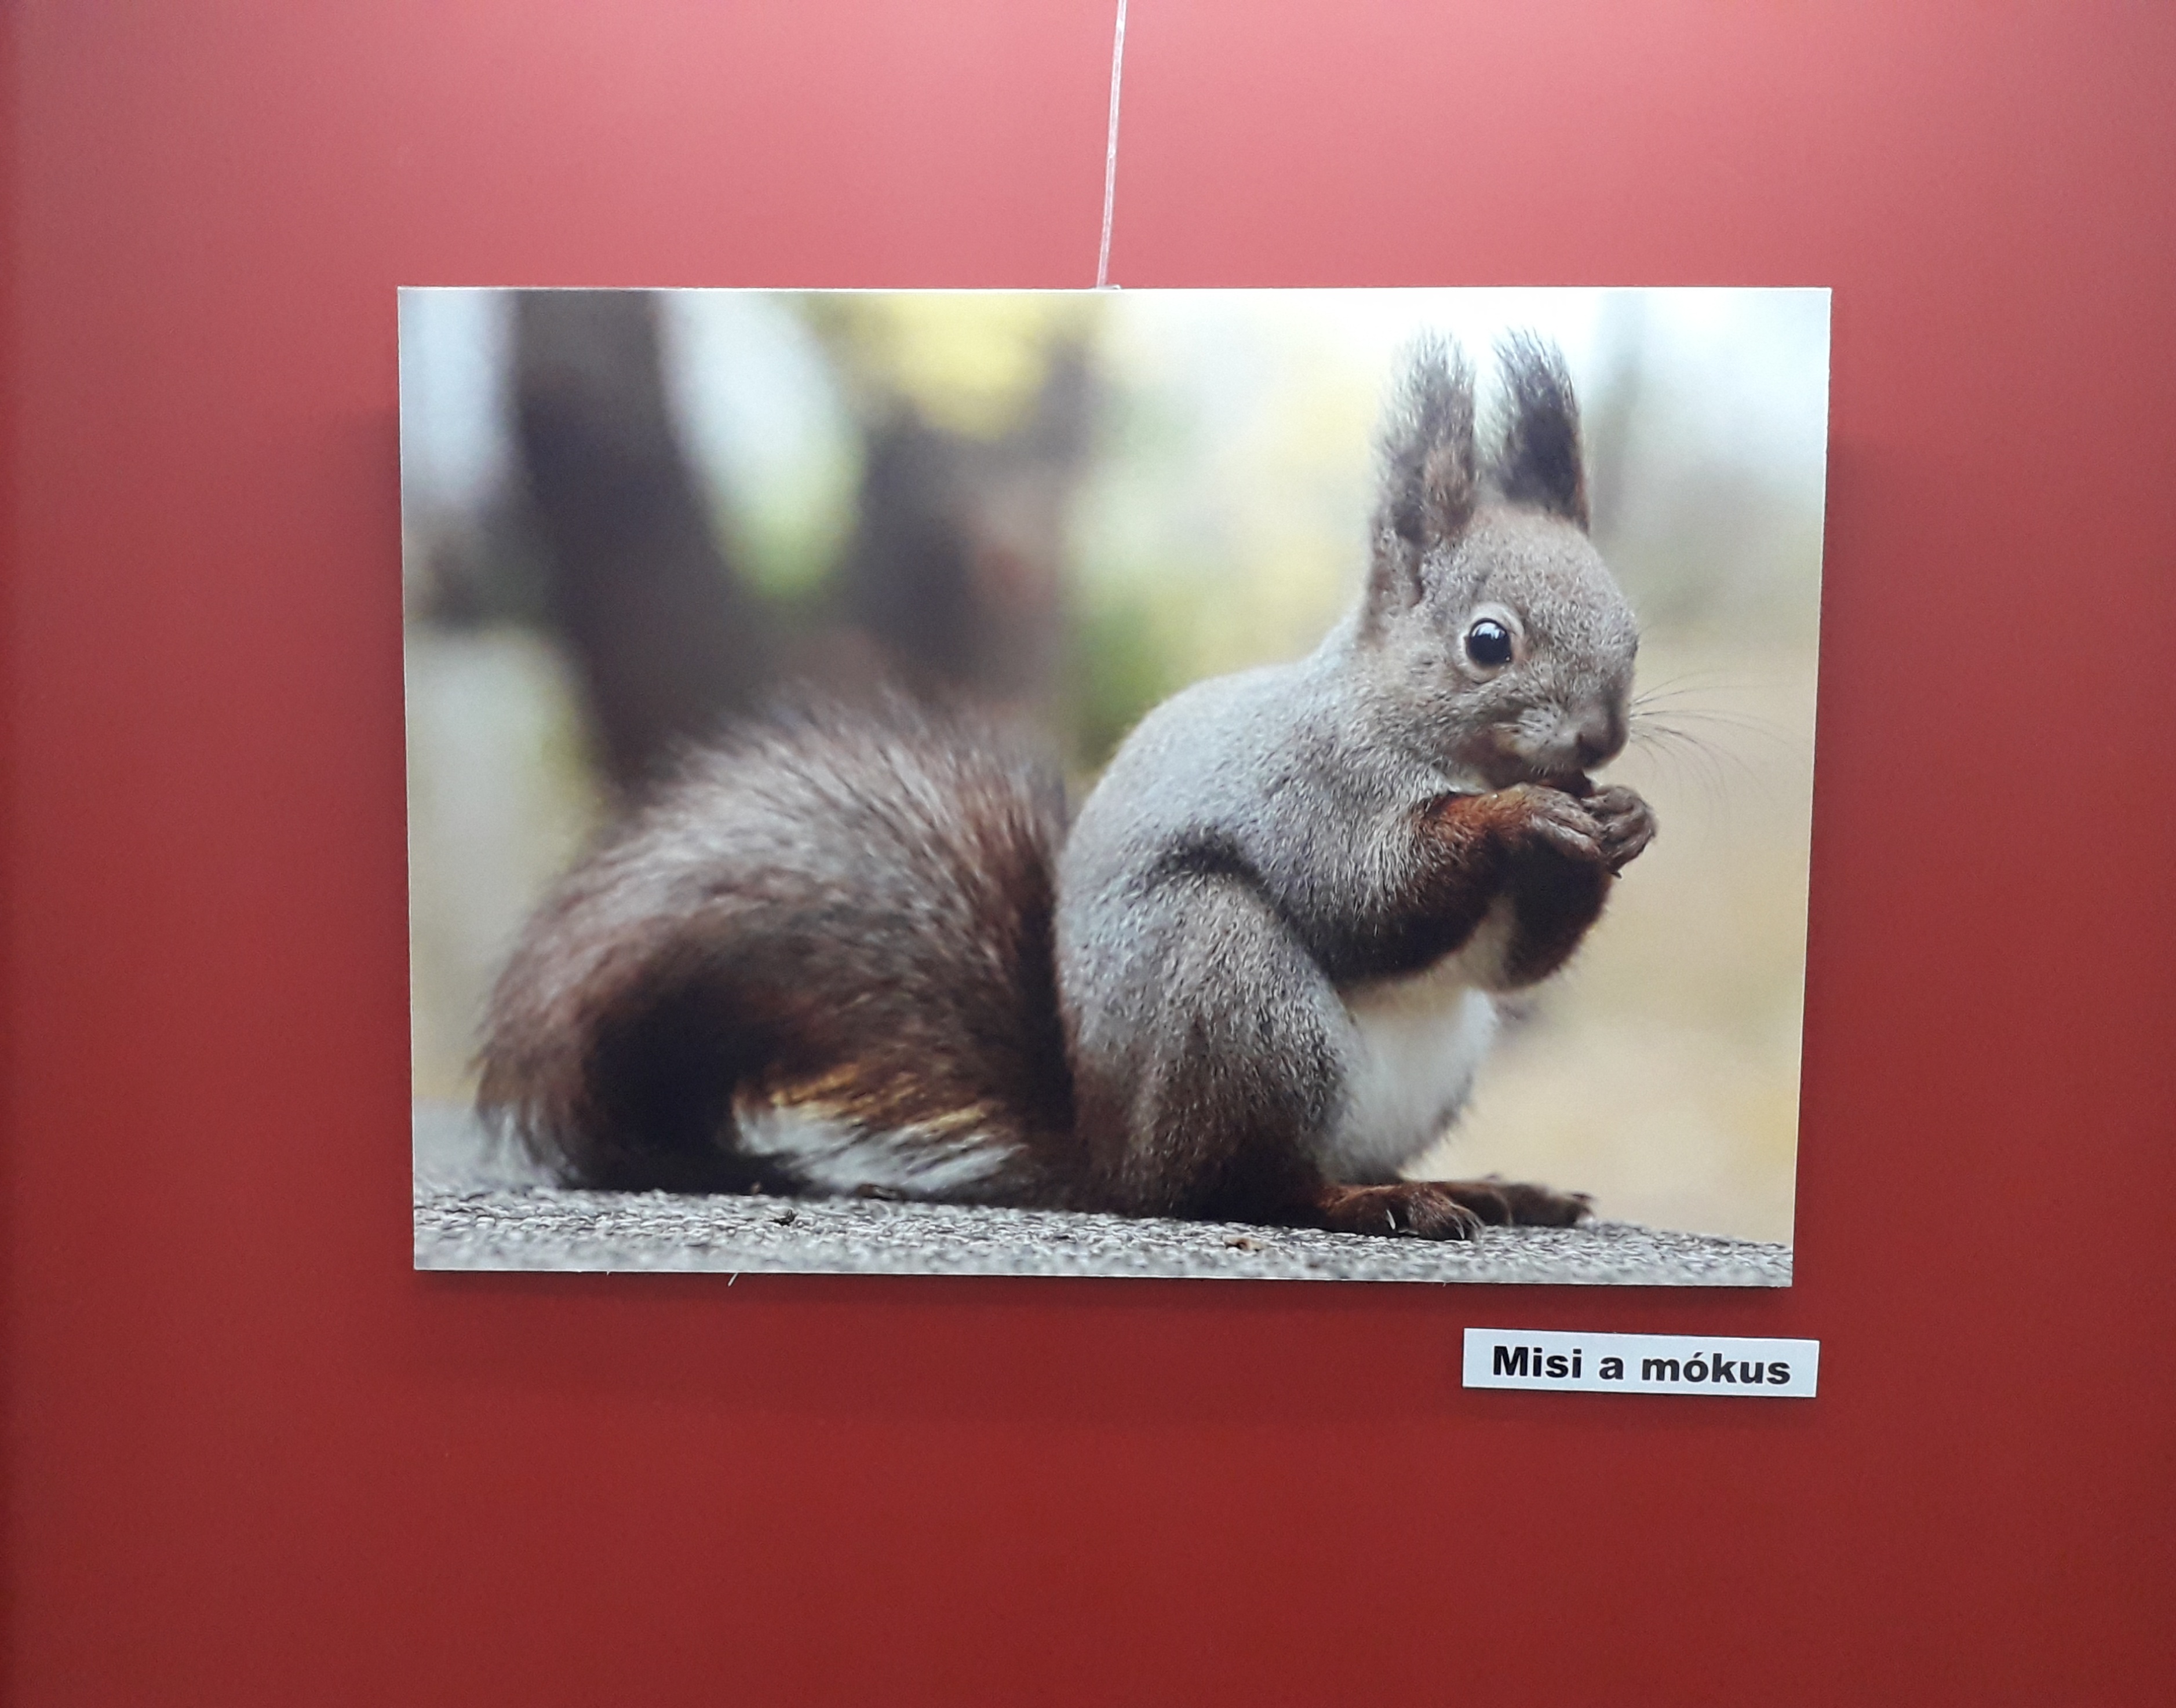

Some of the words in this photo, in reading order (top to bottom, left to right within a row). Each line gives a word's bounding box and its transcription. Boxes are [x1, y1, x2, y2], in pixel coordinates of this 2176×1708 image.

[1493, 1346, 1582, 1378] Misi
[1599, 1357, 1624, 1379] a
[1642, 1352, 1790, 1385] mókus
